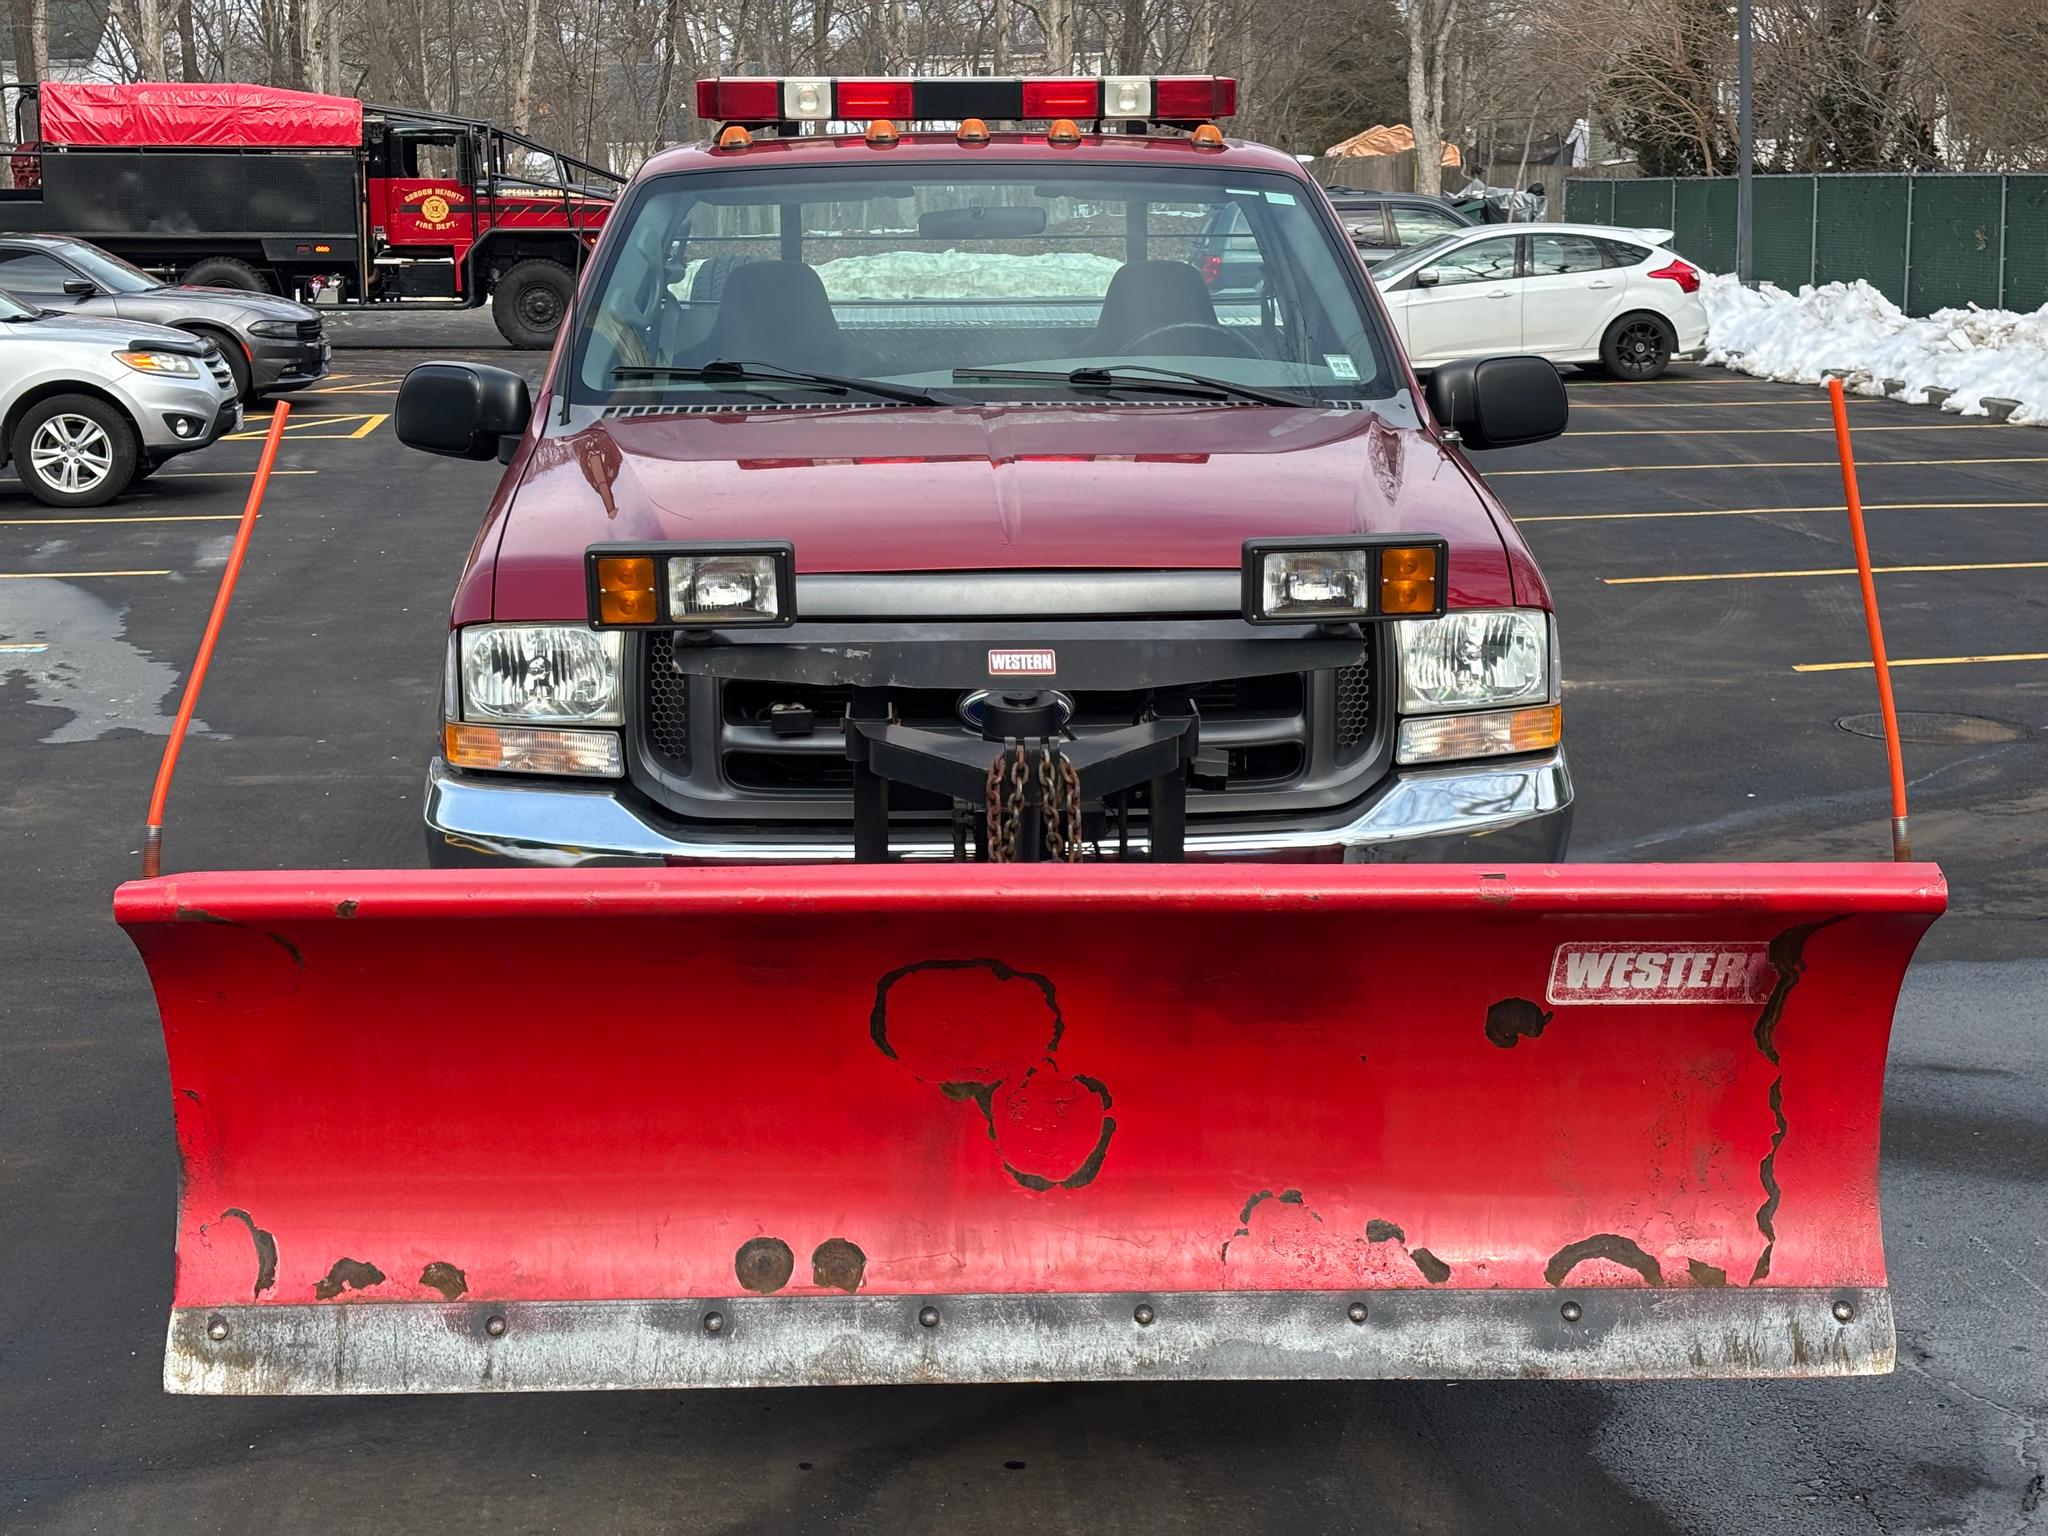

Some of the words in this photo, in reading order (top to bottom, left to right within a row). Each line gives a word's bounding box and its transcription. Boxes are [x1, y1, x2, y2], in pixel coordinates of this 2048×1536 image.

[404, 188, 433, 203] GORDON
[434, 188, 465, 203] HEIGHTS
[501, 188, 535, 197] SPECIAL
[415, 220, 433, 230] FIRE
[991, 654, 1052, 670] WESTERN
